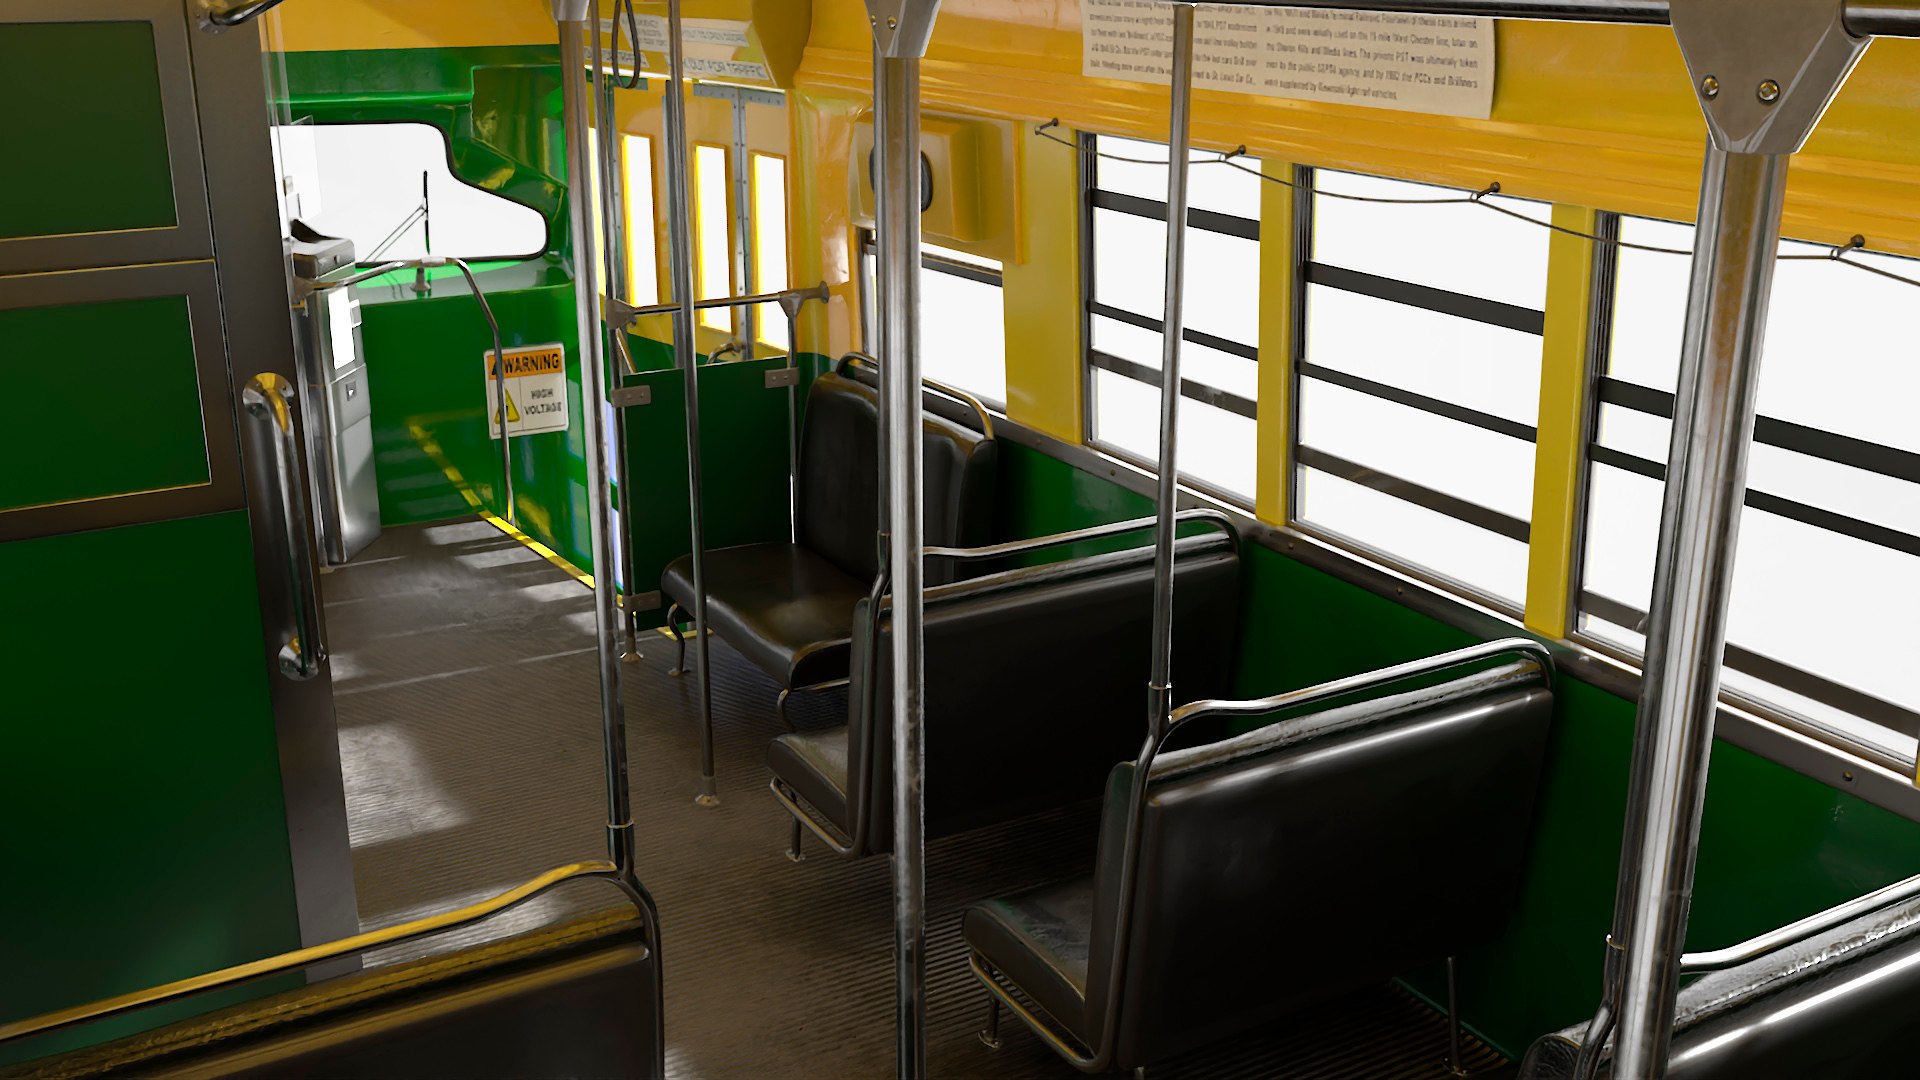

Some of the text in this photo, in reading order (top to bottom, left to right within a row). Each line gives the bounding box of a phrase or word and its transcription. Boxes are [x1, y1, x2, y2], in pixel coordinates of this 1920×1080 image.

[1469, 40, 1478, 48] on
[1396, 52, 1408, 63] PST
[1411, 56, 1424, 64] was
[708, 60, 726, 72] FOR
[728, 63, 764, 77] TRAFFIC
[503, 353, 559, 373] WARNING
[531, 388, 553, 399] HIGH
[524, 402, 562, 415] VOLTAGE
